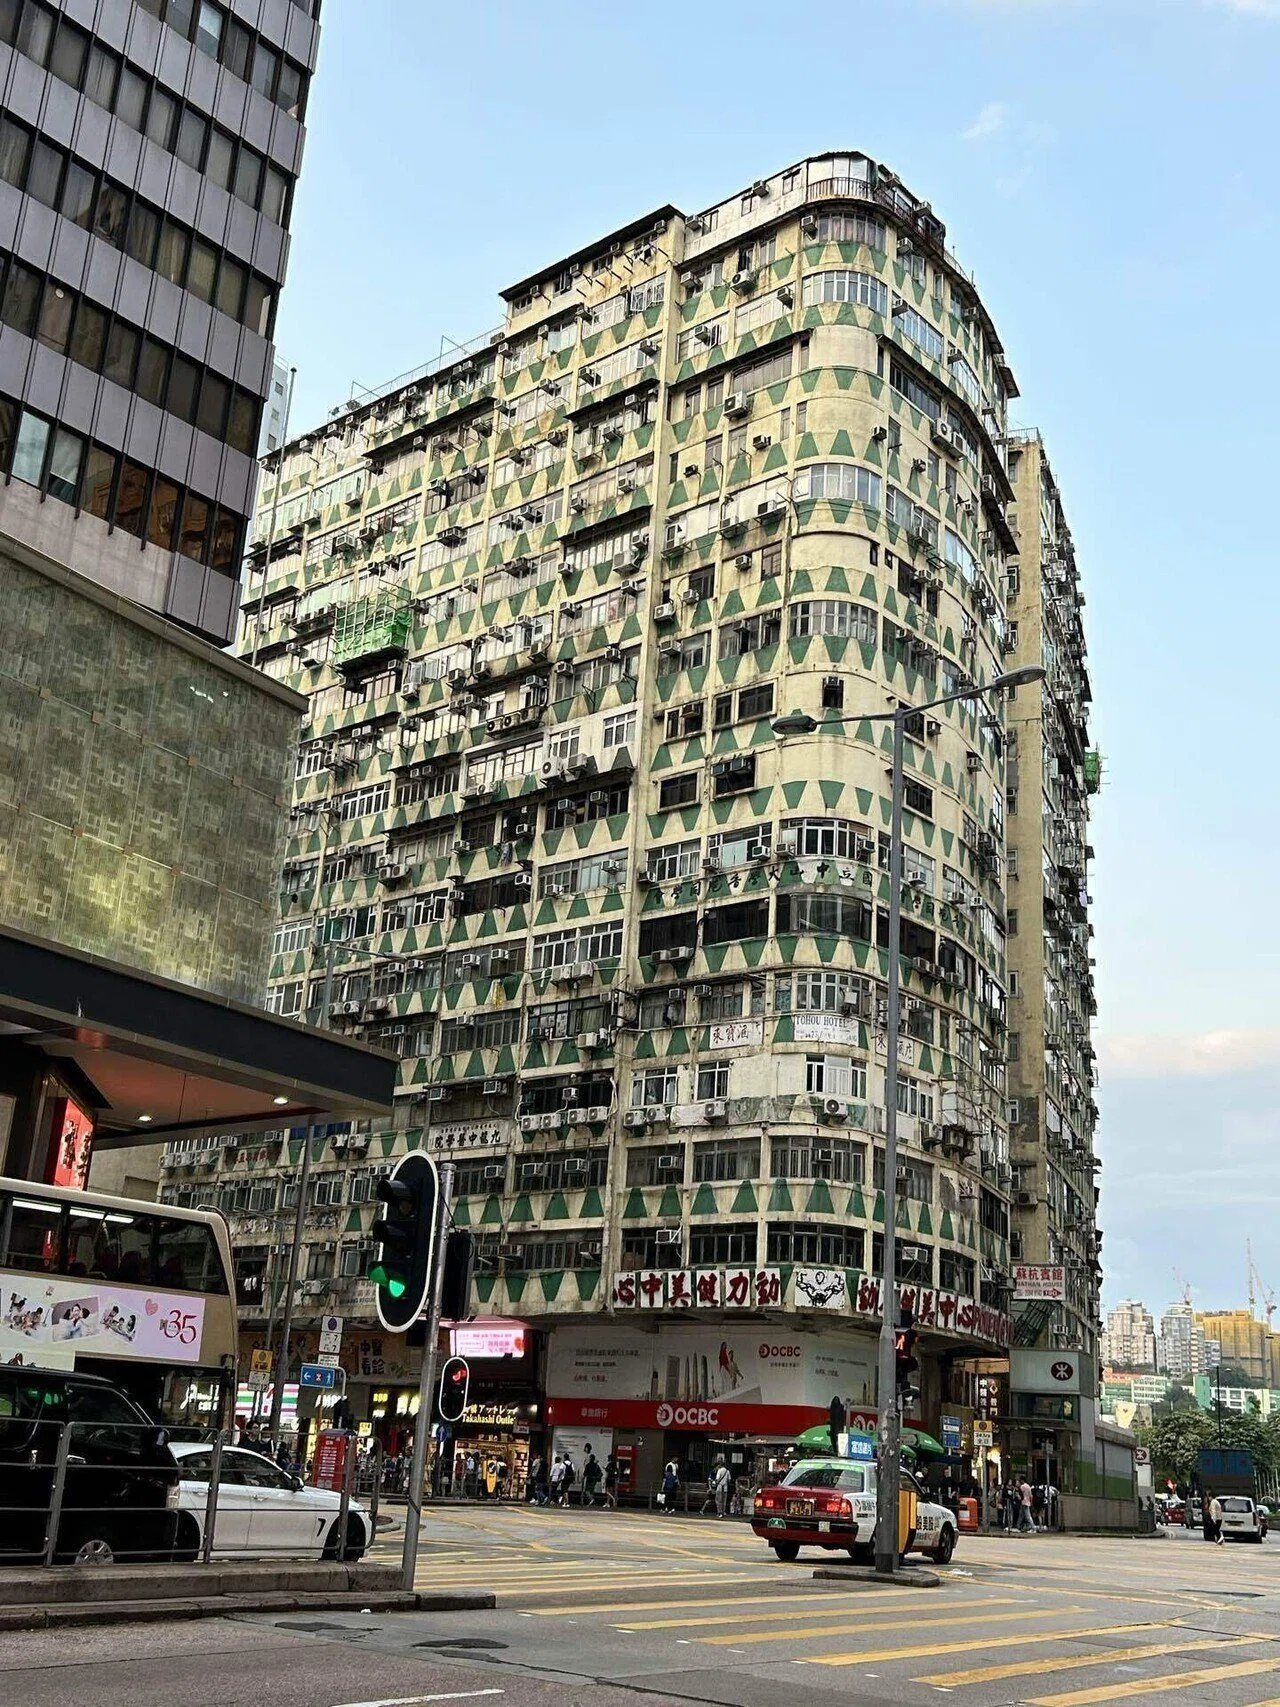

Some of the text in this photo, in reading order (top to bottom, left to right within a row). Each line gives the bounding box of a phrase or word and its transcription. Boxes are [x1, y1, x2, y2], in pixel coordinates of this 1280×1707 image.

[796, 1014, 847, 1028] TOHOU HOTEL
[163, 1309, 197, 1345] 35
[770, 1345, 801, 1358] OCBC
[462, 1413, 495, 1424] Takahashi
[674, 1406, 719, 1426] OCBC
